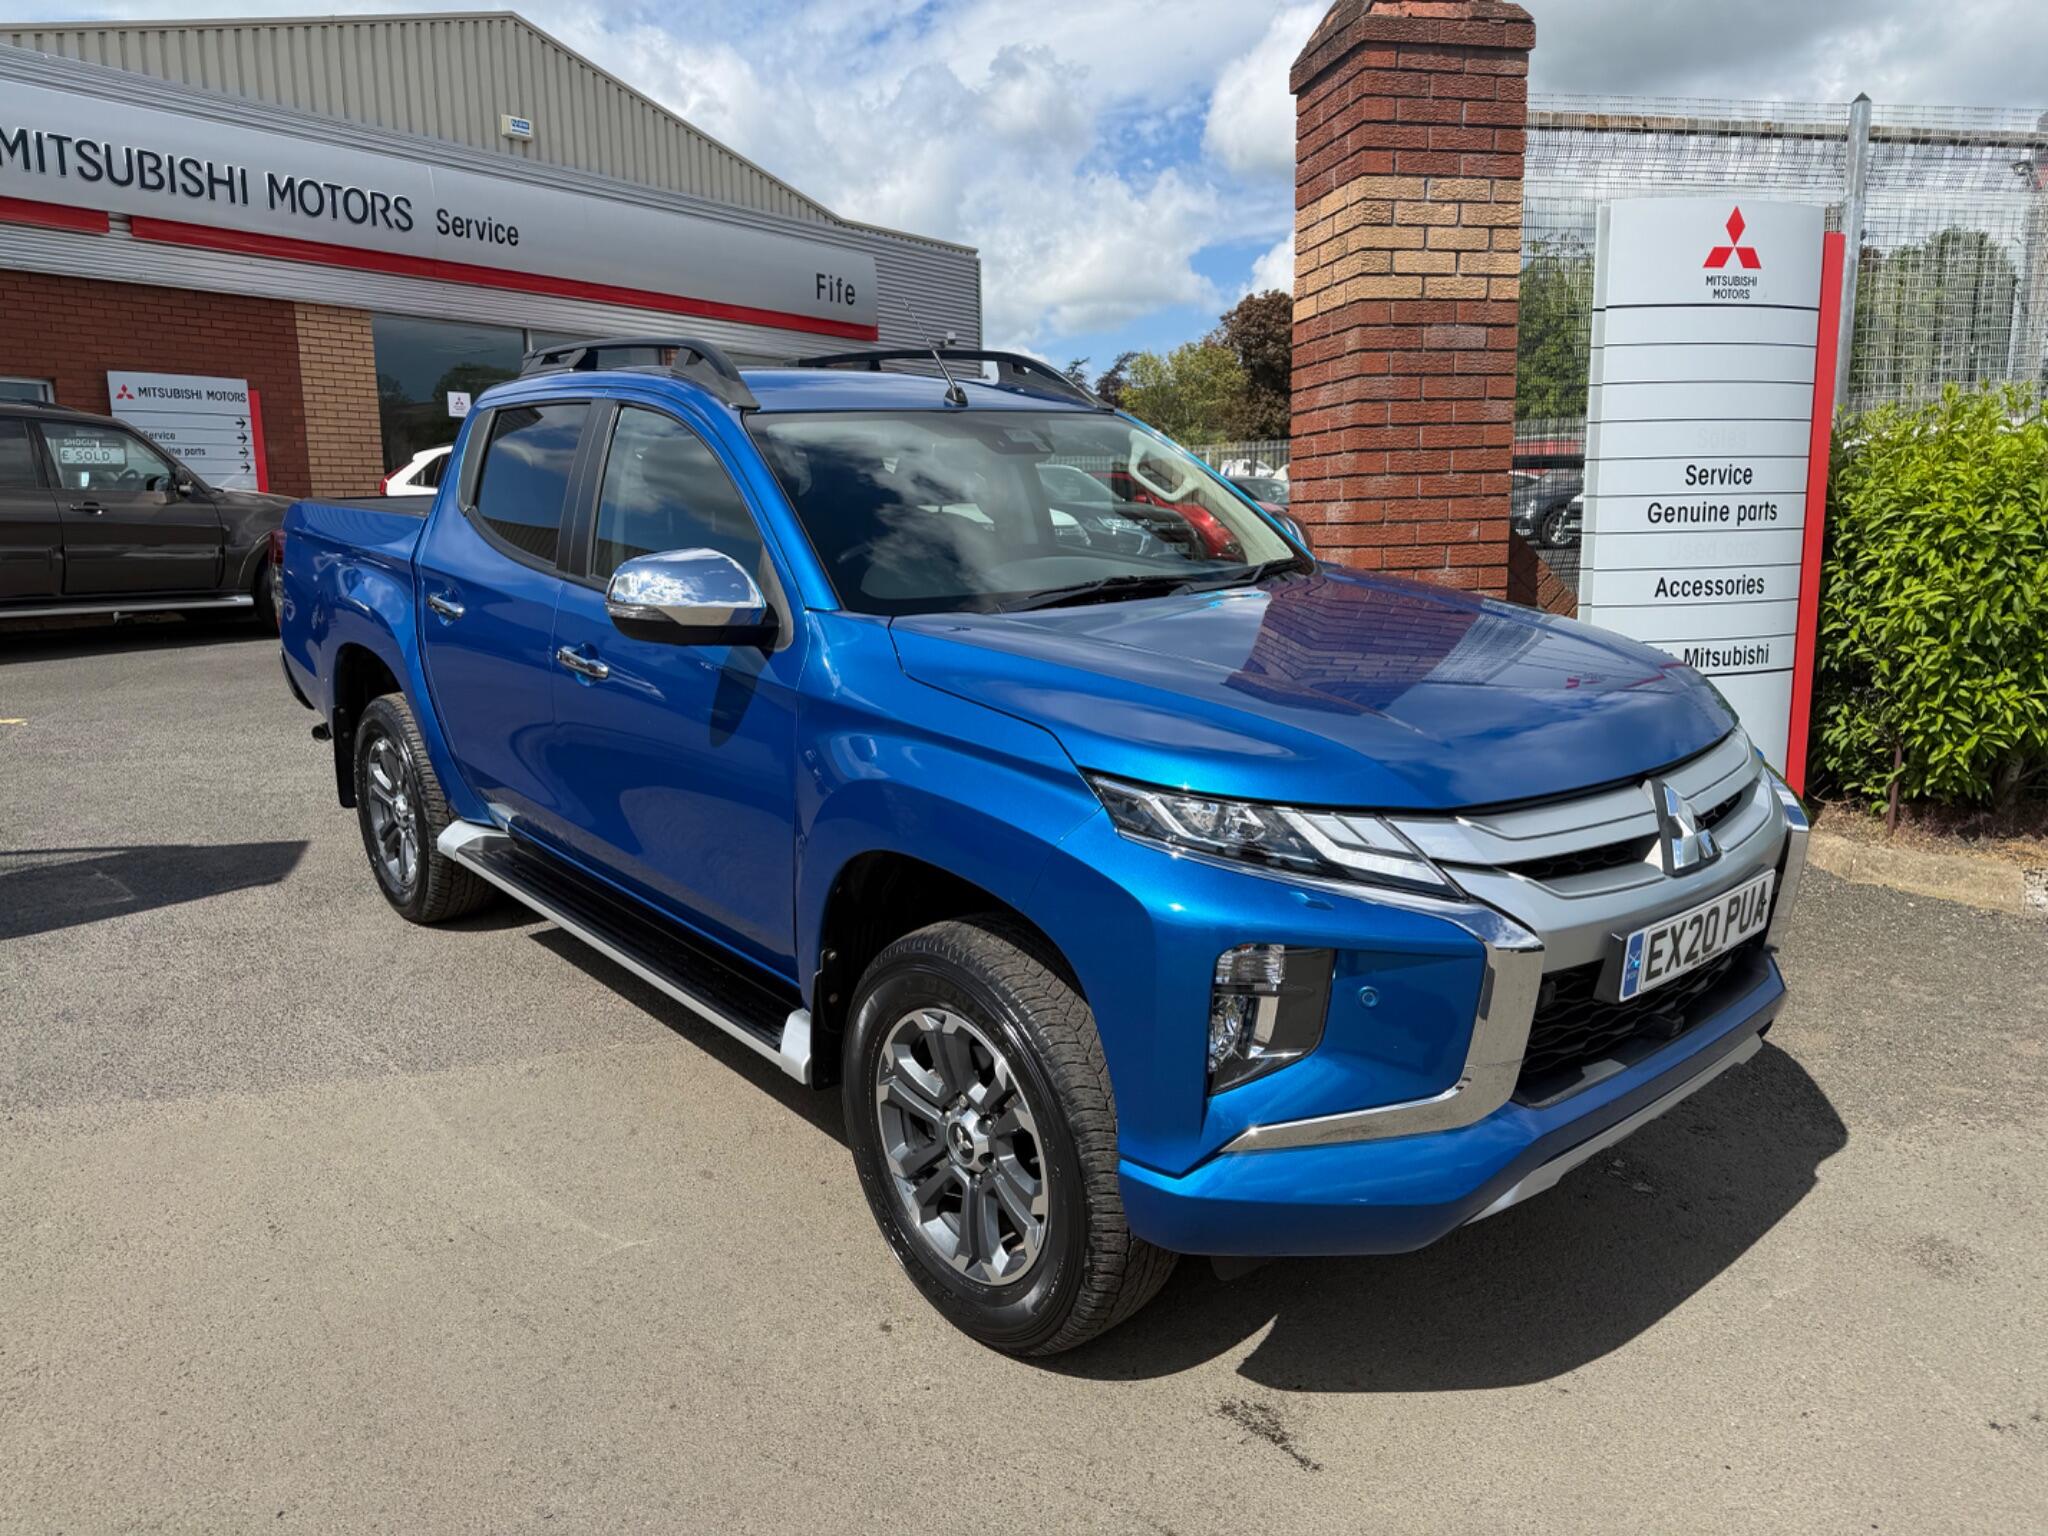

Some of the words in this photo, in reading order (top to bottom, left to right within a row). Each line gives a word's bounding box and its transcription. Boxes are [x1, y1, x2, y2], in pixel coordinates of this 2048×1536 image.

[0, 127, 249, 206] MITSUBISHI
[264, 171, 414, 232] MOTORS
[436, 208, 519, 247] Service
[815, 272, 856, 306] Fife
[1706, 275, 1758, 286] MITSUBISHI
[1712, 288, 1750, 299] MOTORS
[138, 387, 202, 401] MITSUBISHI
[206, 391, 247, 404] MOTORS
[75, 450, 110, 461] SOLD
[1685, 464, 1753, 486] Service
[1647, 501, 1730, 523] Genuine
[1737, 501, 1778, 526] parts
[1654, 574, 1765, 598] Accessories
[1684, 643, 1770, 668] Mitsubishi
[1645, 906, 1720, 982] EX20
[1722, 881, 1767, 944] PUA
